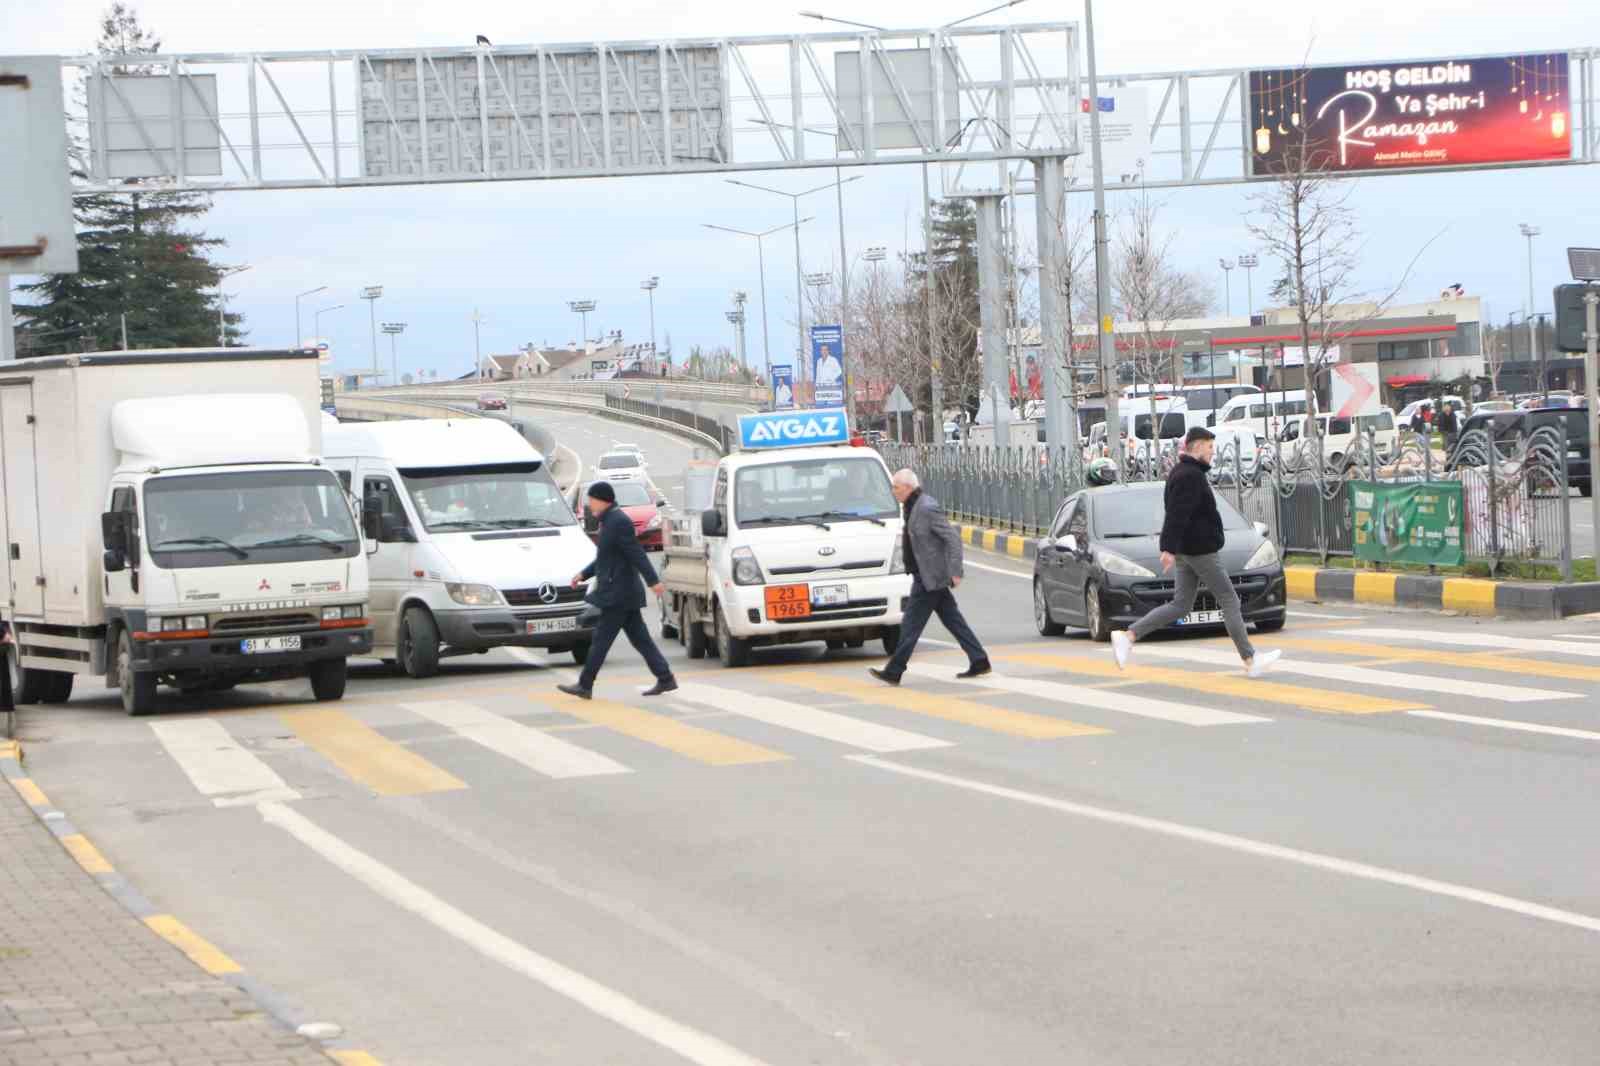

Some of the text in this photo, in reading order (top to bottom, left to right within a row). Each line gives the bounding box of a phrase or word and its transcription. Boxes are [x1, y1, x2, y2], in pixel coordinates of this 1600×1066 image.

[1345, 61, 1471, 93] HOŞ GELDİN
[1395, 91, 1485, 117] Ya Şehr-i
[1317, 90, 1458, 166] Ramazan
[749, 416, 841, 441] AYGAZ
[778, 587, 794, 600] 23
[221, 599, 310, 612] MITSUBISHI
[771, 602, 805, 617] 1965
[1198, 612, 1210, 622] ET
[246, 639, 257, 650] 61
[264, 638, 271, 649] K
